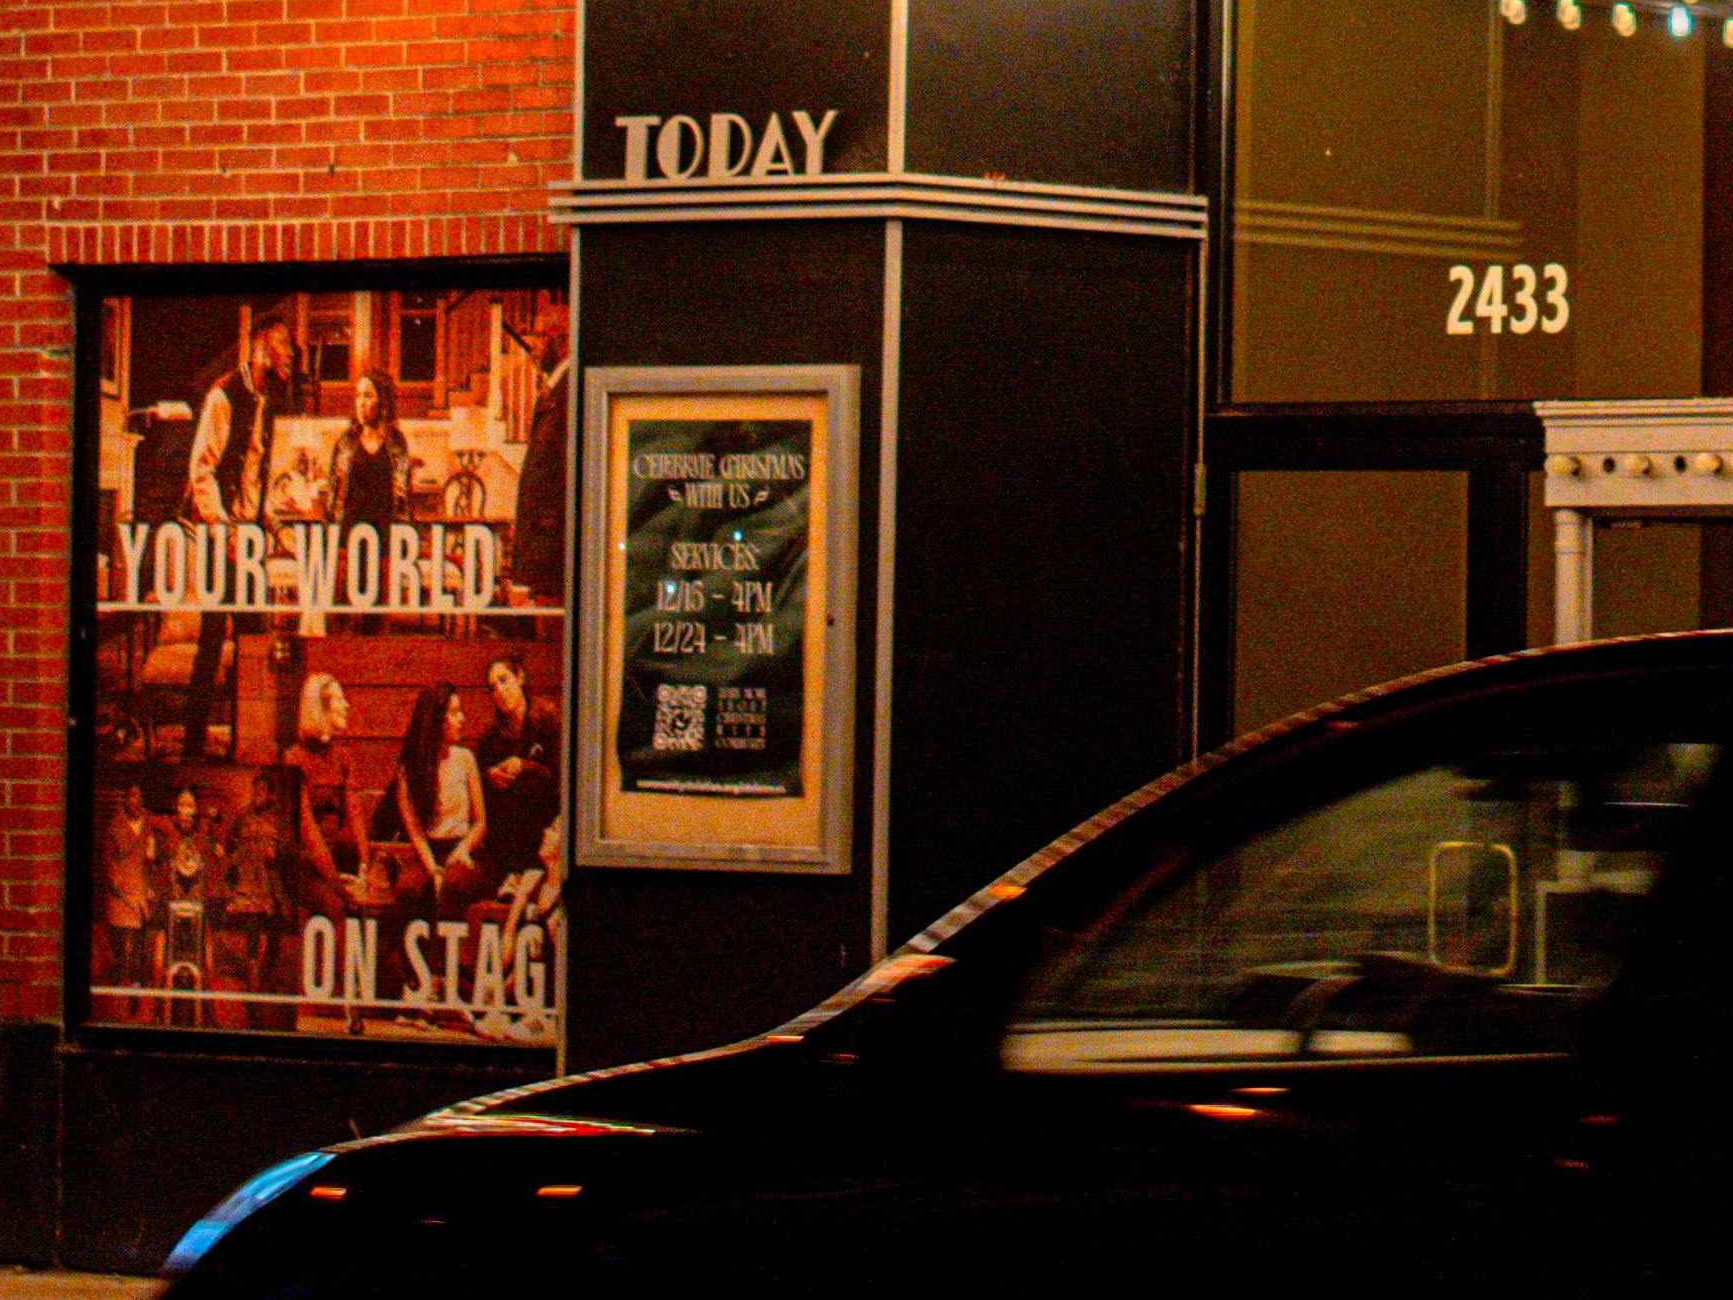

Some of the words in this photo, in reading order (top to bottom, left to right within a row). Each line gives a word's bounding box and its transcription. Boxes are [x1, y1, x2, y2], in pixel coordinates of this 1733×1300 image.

[614, 108, 840, 181] TODAY
[1446, 262, 1570, 335] 2433
[684, 481, 724, 509] WITH
[728, 482, 752, 509] US
[118, 522, 268, 610] YOUR
[292, 522, 497, 612] WORLD
[731, 581, 774, 614] 4PM
[653, 622, 706, 654] 12/24
[733, 622, 775, 655] 4PM
[302, 916, 379, 1004] ON
[403, 918, 549, 1009] STAG
